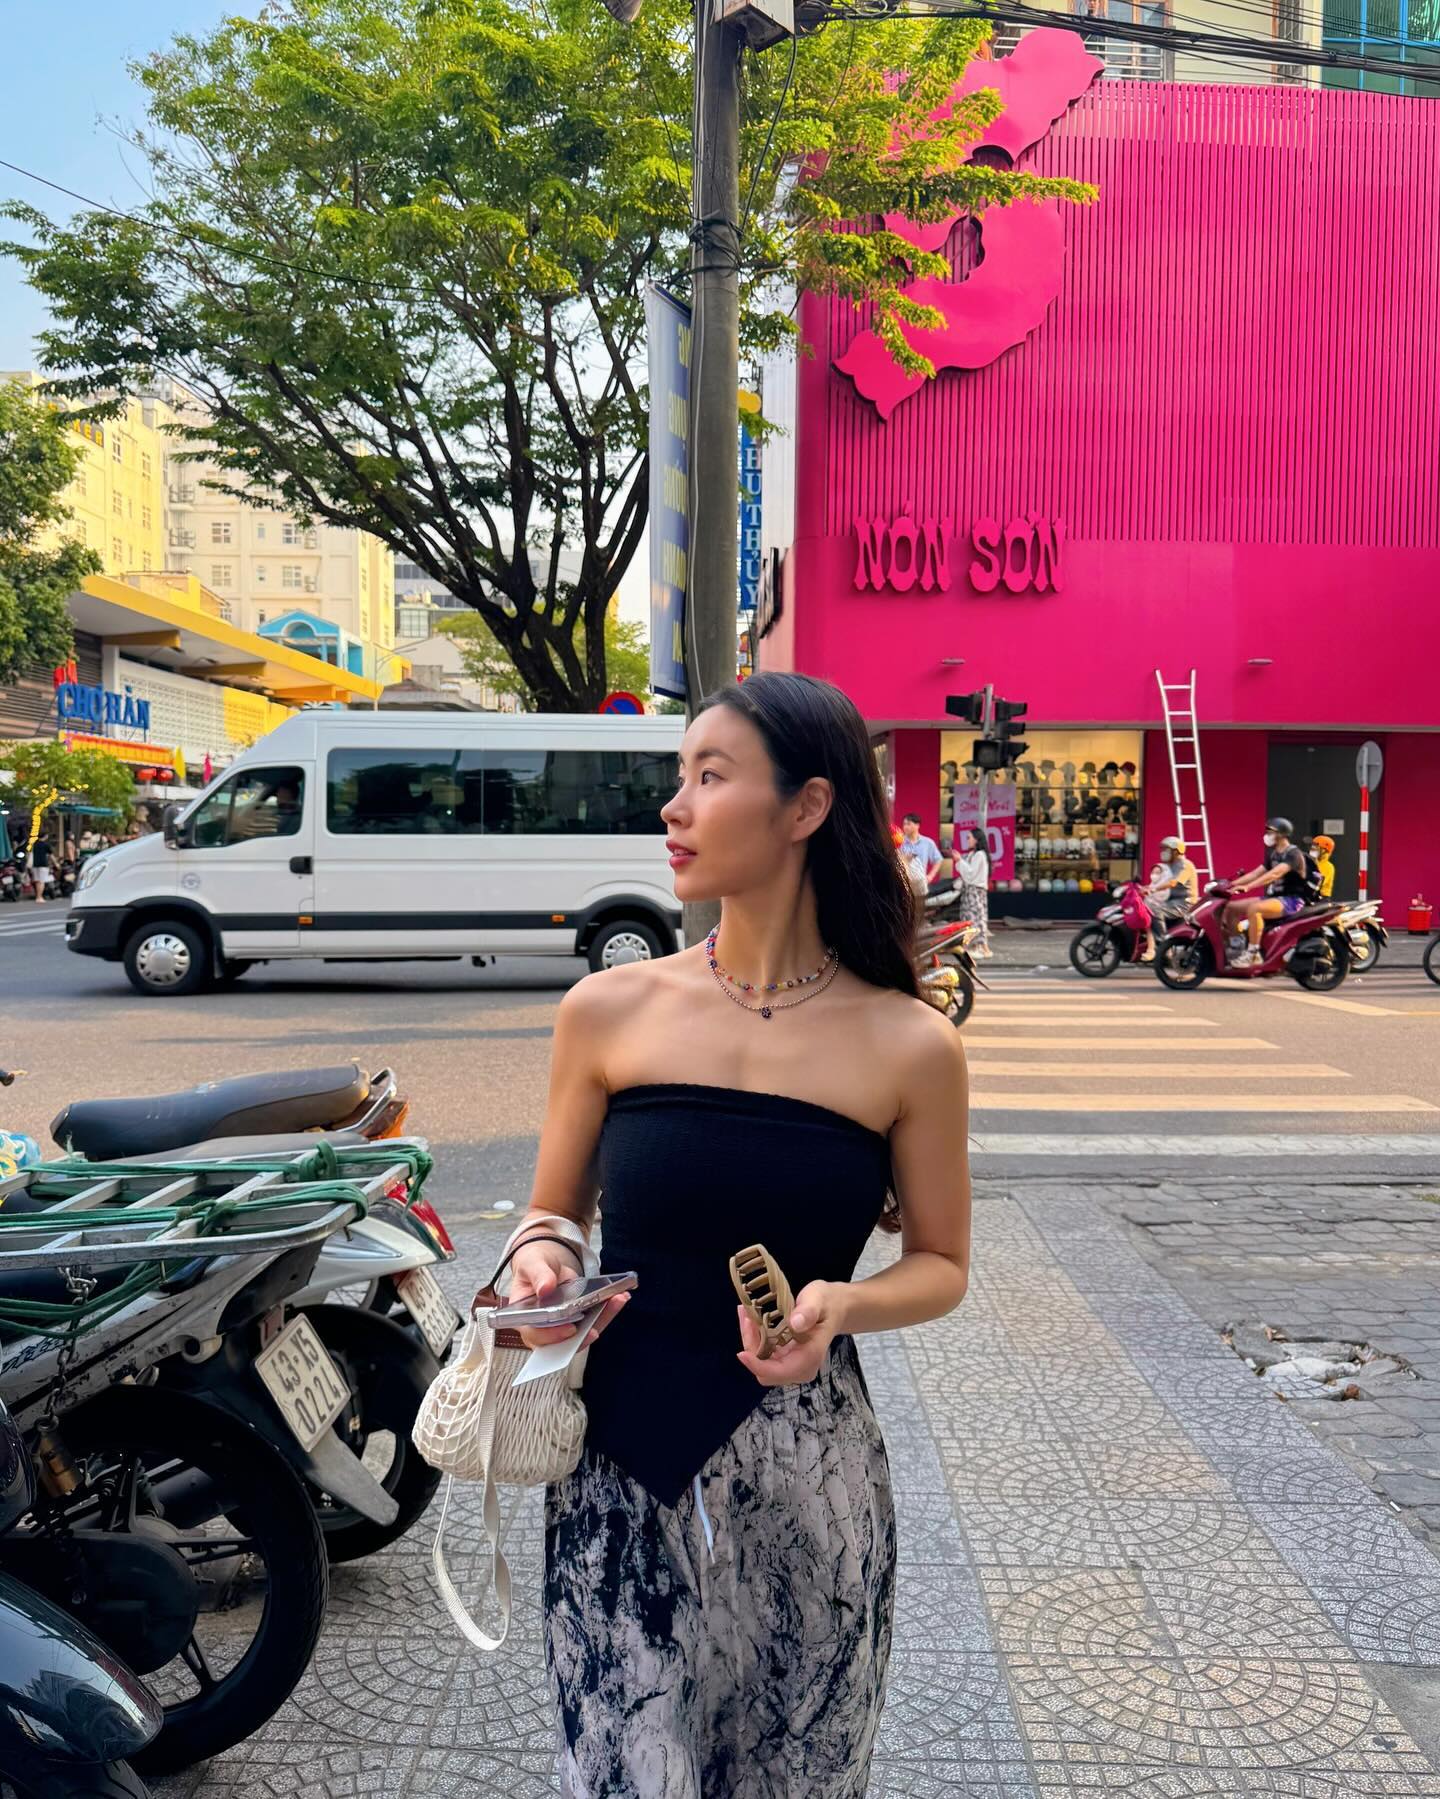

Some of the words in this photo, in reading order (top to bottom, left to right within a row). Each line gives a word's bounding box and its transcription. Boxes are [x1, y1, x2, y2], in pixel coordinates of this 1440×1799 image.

[854, 500, 951, 592] NÓN
[969, 511, 1066, 593] SƠN
[56, 683, 103, 731] CHỢ
[105, 685, 150, 730] HÀN
[295, 1366, 341, 1434] 0224
